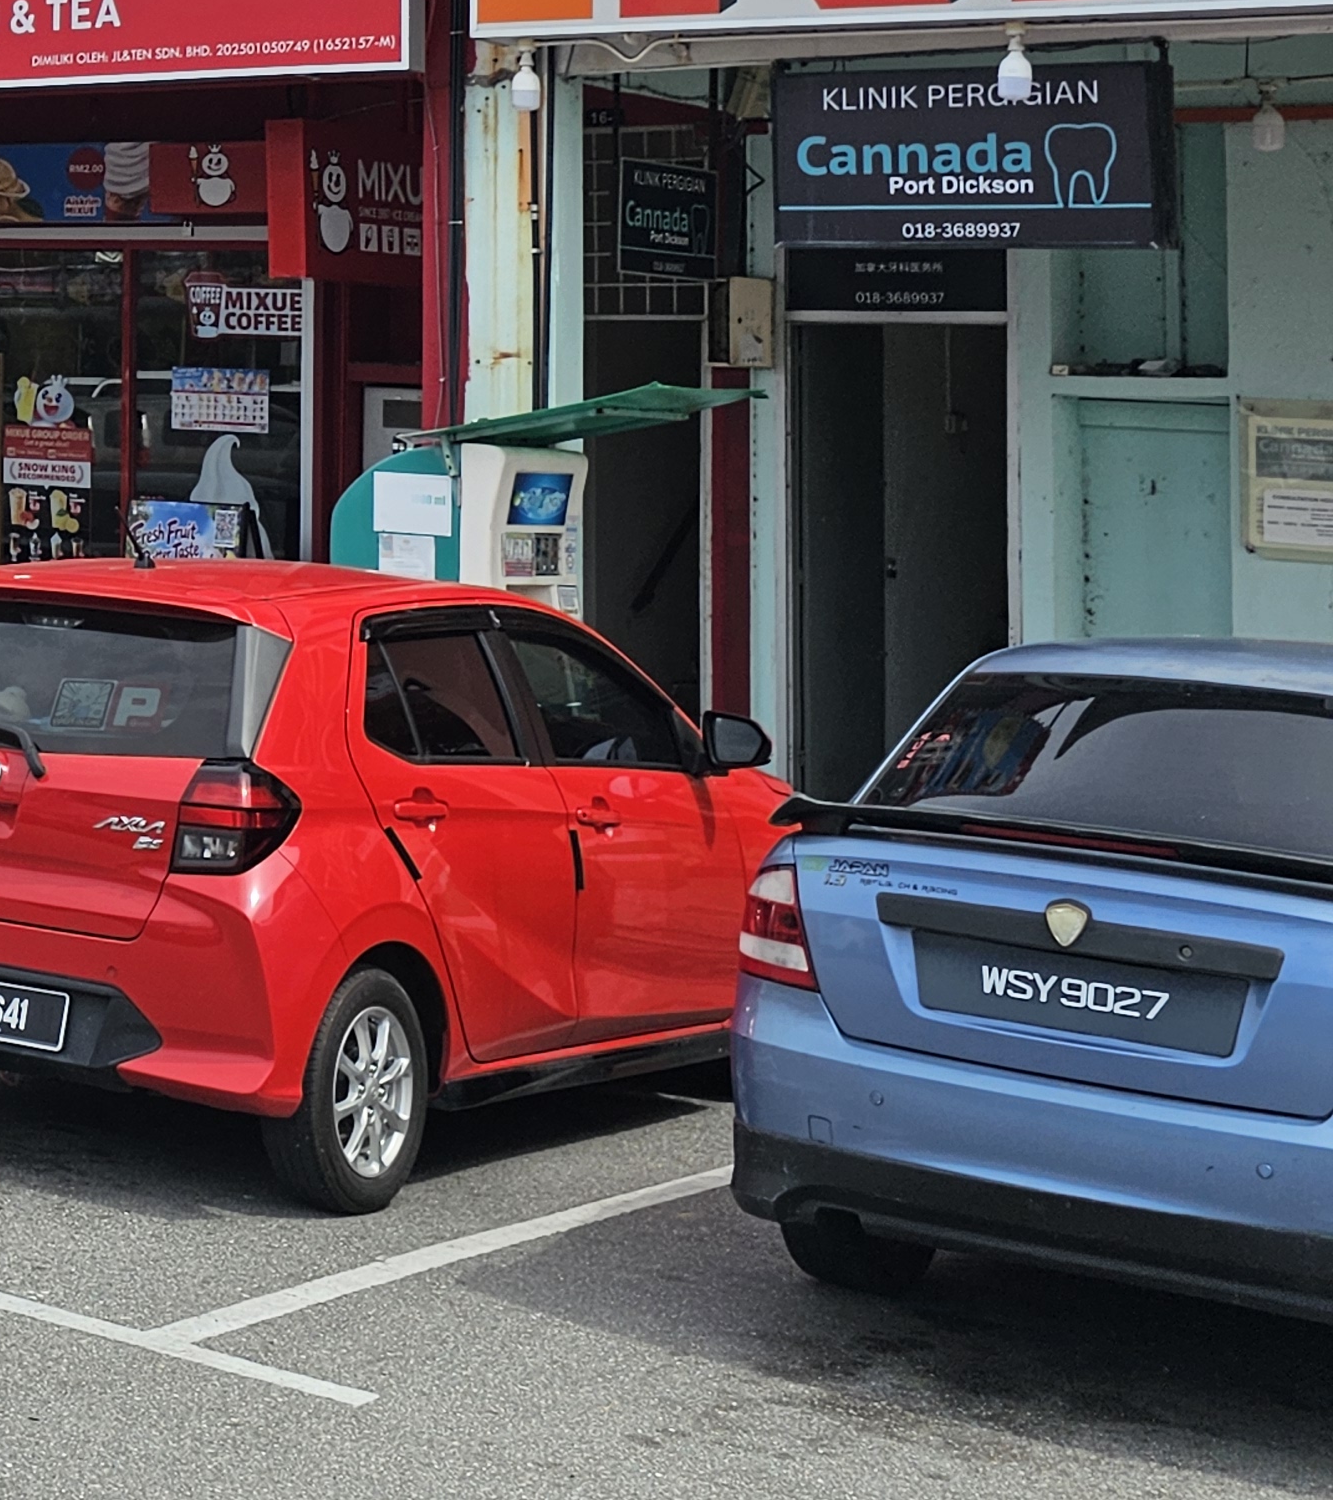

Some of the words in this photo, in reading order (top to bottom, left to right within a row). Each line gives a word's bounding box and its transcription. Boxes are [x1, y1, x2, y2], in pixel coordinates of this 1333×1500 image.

[31, 52, 75, 68] DIMILIKI
[76, 50, 109, 65] OLEH:
[111, 48, 152, 63] JL&TEN
[154, 46, 183, 60] SDN.
[186, 44, 213, 59] BHD.
[215, 38, 311, 57] 202501050749
[313, 33, 397, 55] (1652157-M)
[822, 84, 919, 113] KLINIK
[927, 79, 1099, 108] PERGGIAN
[796, 132, 1033, 177] Cannada
[69, 164, 104, 174] RM2.00
[889, 176, 937, 196] Port
[941, 174, 1034, 195] Dickson
[625, 201, 690, 233] Cannada
[902, 221, 1021, 240] 018-3689937
[189, 285, 221, 304] COFFEE
[224, 290, 302, 313] MIXUE
[855, 291, 945, 304] 018-3689937
[224, 312, 302, 333] COFFEE
[18, 462, 48, 473] SNOW
[51, 463, 76, 474] KING
[166, 519, 198, 545] Fruit
[829, 858, 890, 878] JAPAN
